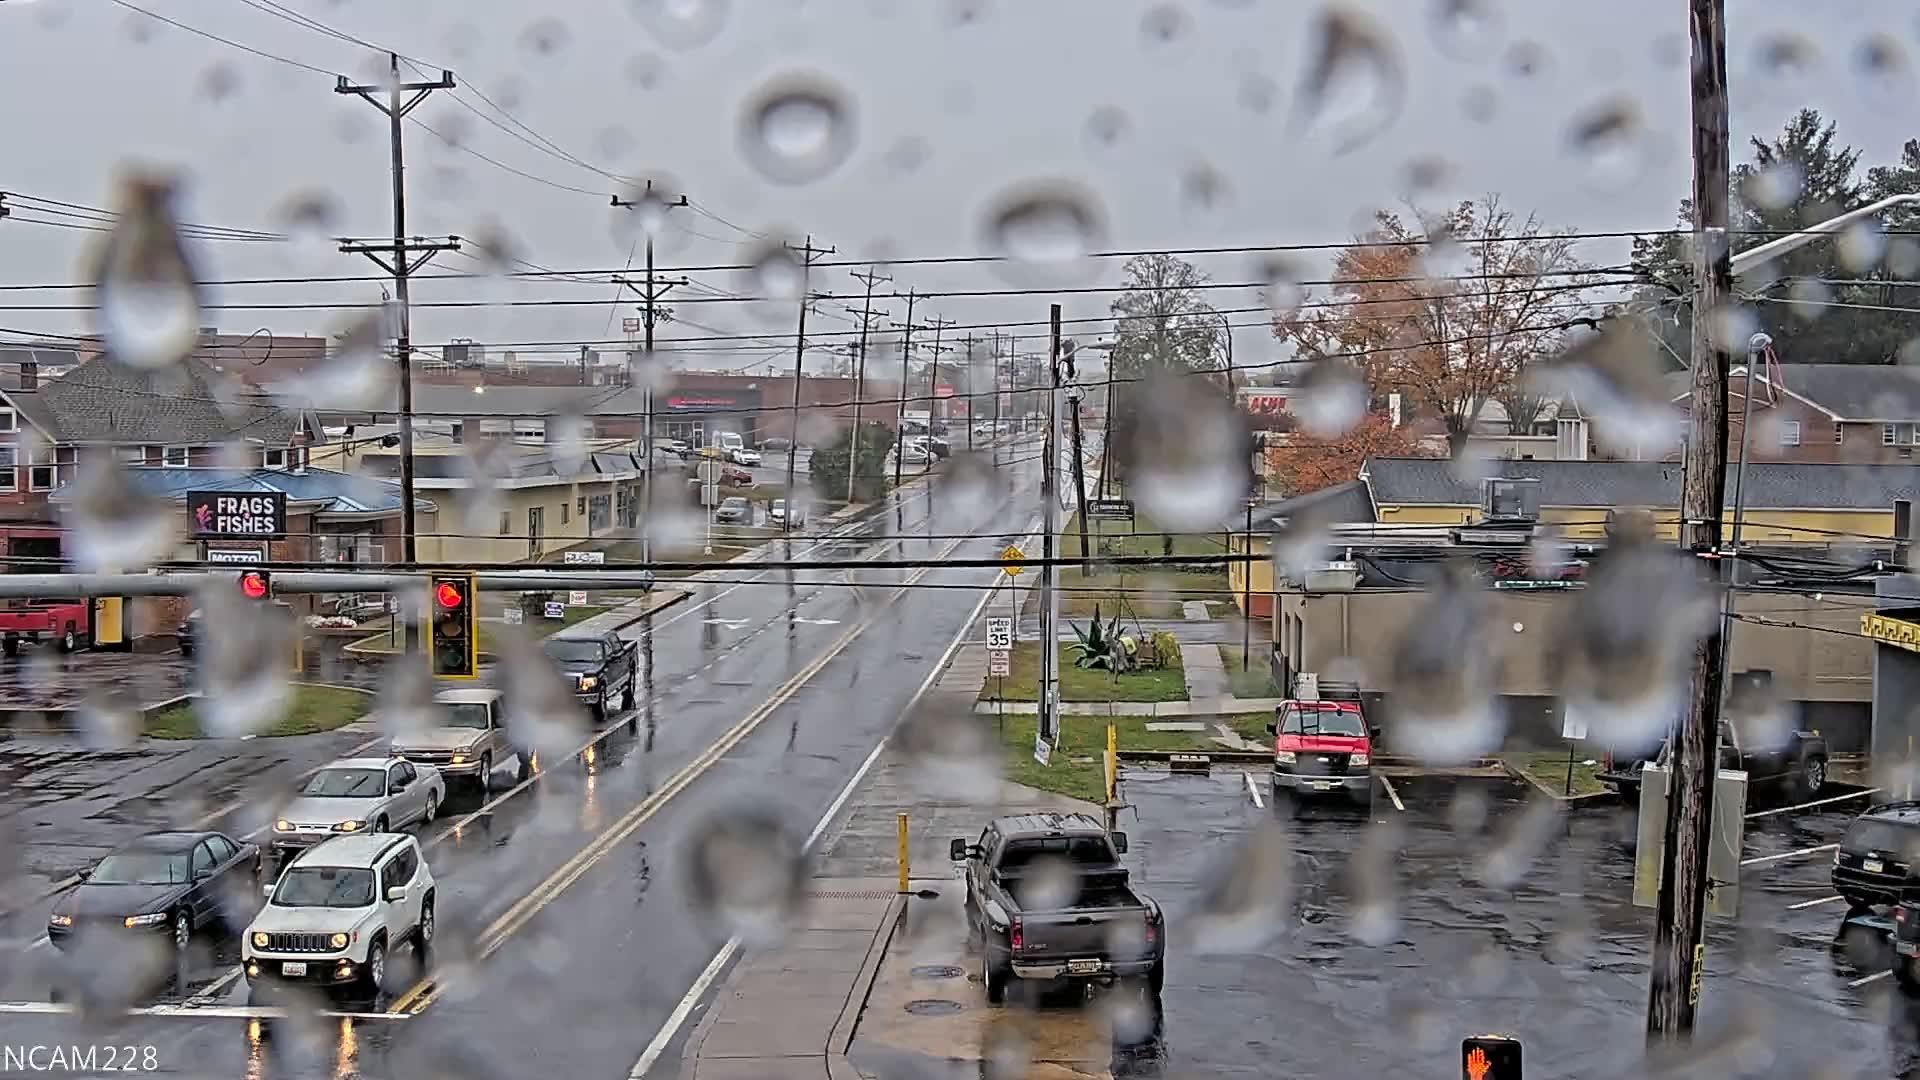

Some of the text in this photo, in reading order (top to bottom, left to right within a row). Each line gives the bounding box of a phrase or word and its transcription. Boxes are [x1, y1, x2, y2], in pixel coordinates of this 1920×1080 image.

[217, 497, 275, 514] FRAGS
[217, 515, 275, 533] FISHES
[989, 633, 1009, 646] 35
